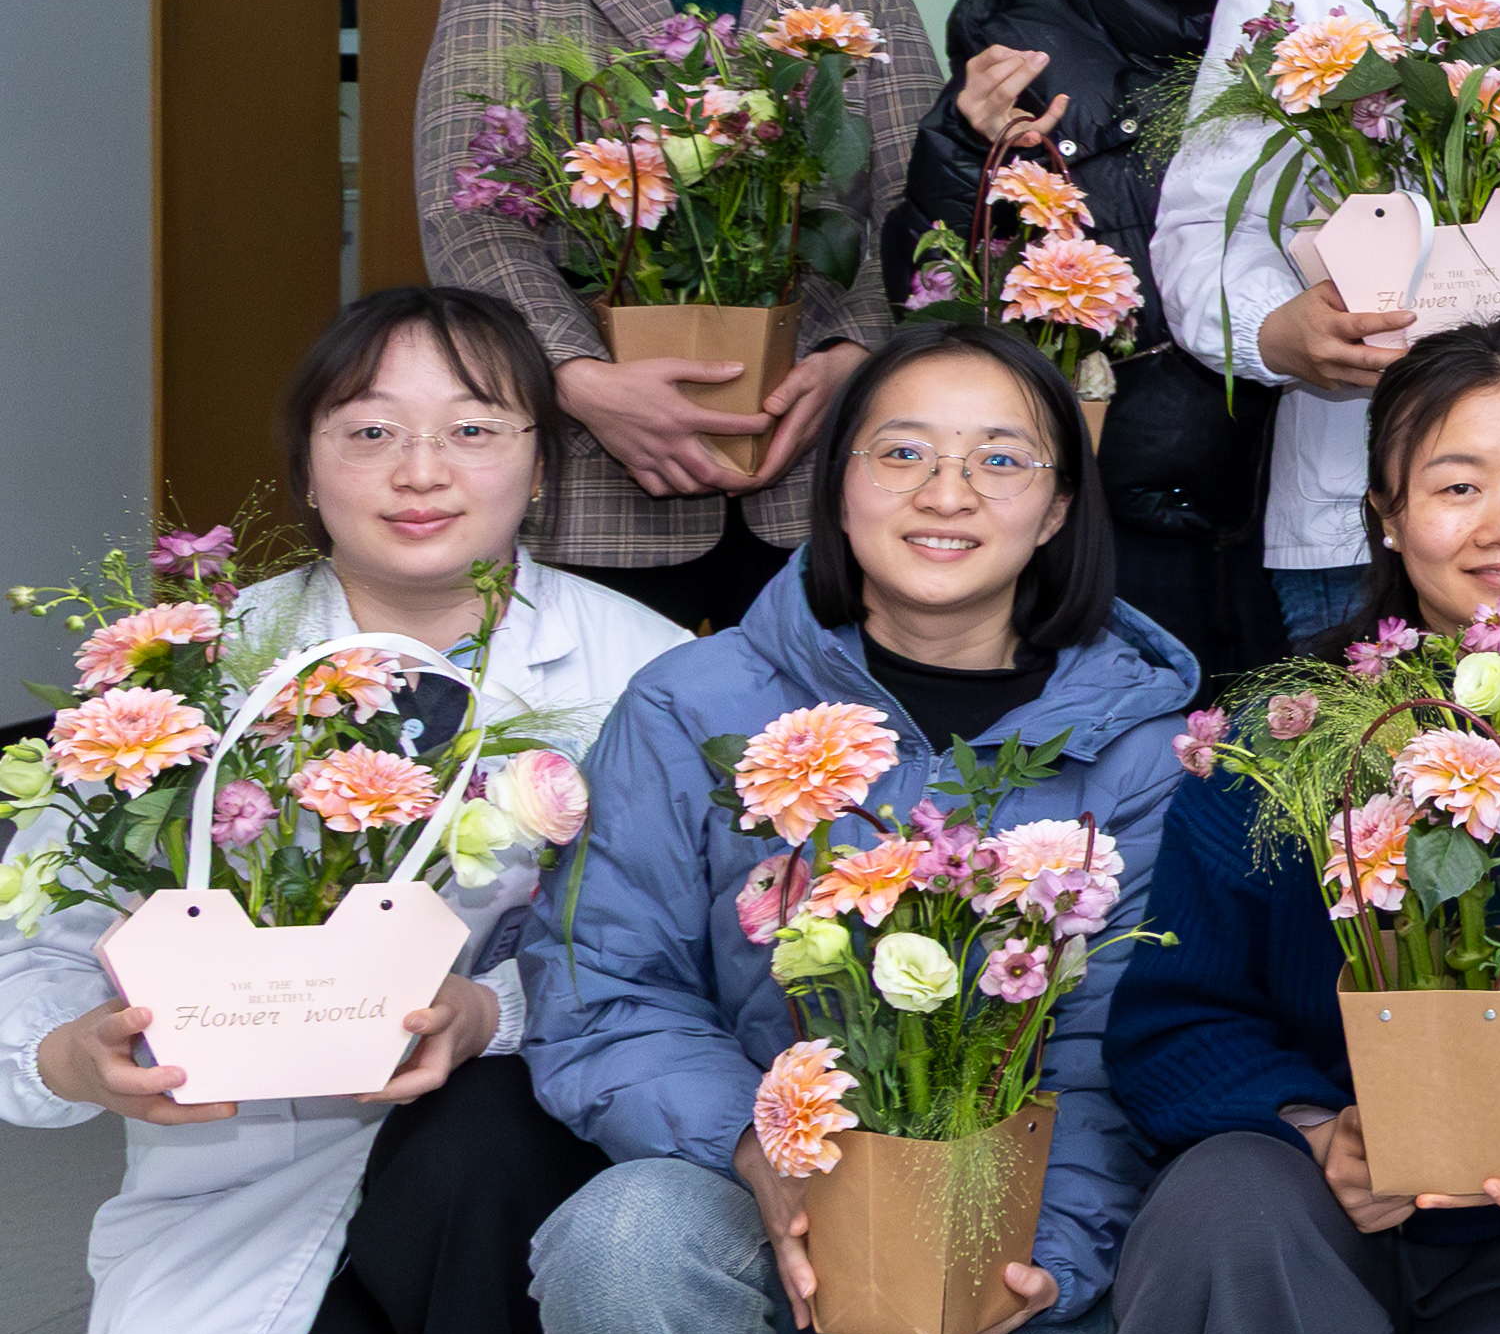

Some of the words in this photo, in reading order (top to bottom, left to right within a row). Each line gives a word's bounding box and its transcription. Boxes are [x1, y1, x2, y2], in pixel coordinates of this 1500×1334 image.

[268, 980, 293, 990] THE
[249, 992, 316, 1004] BEAUTIFUL
[174, 1005, 281, 1030] Flower
[304, 996, 387, 1023] world
